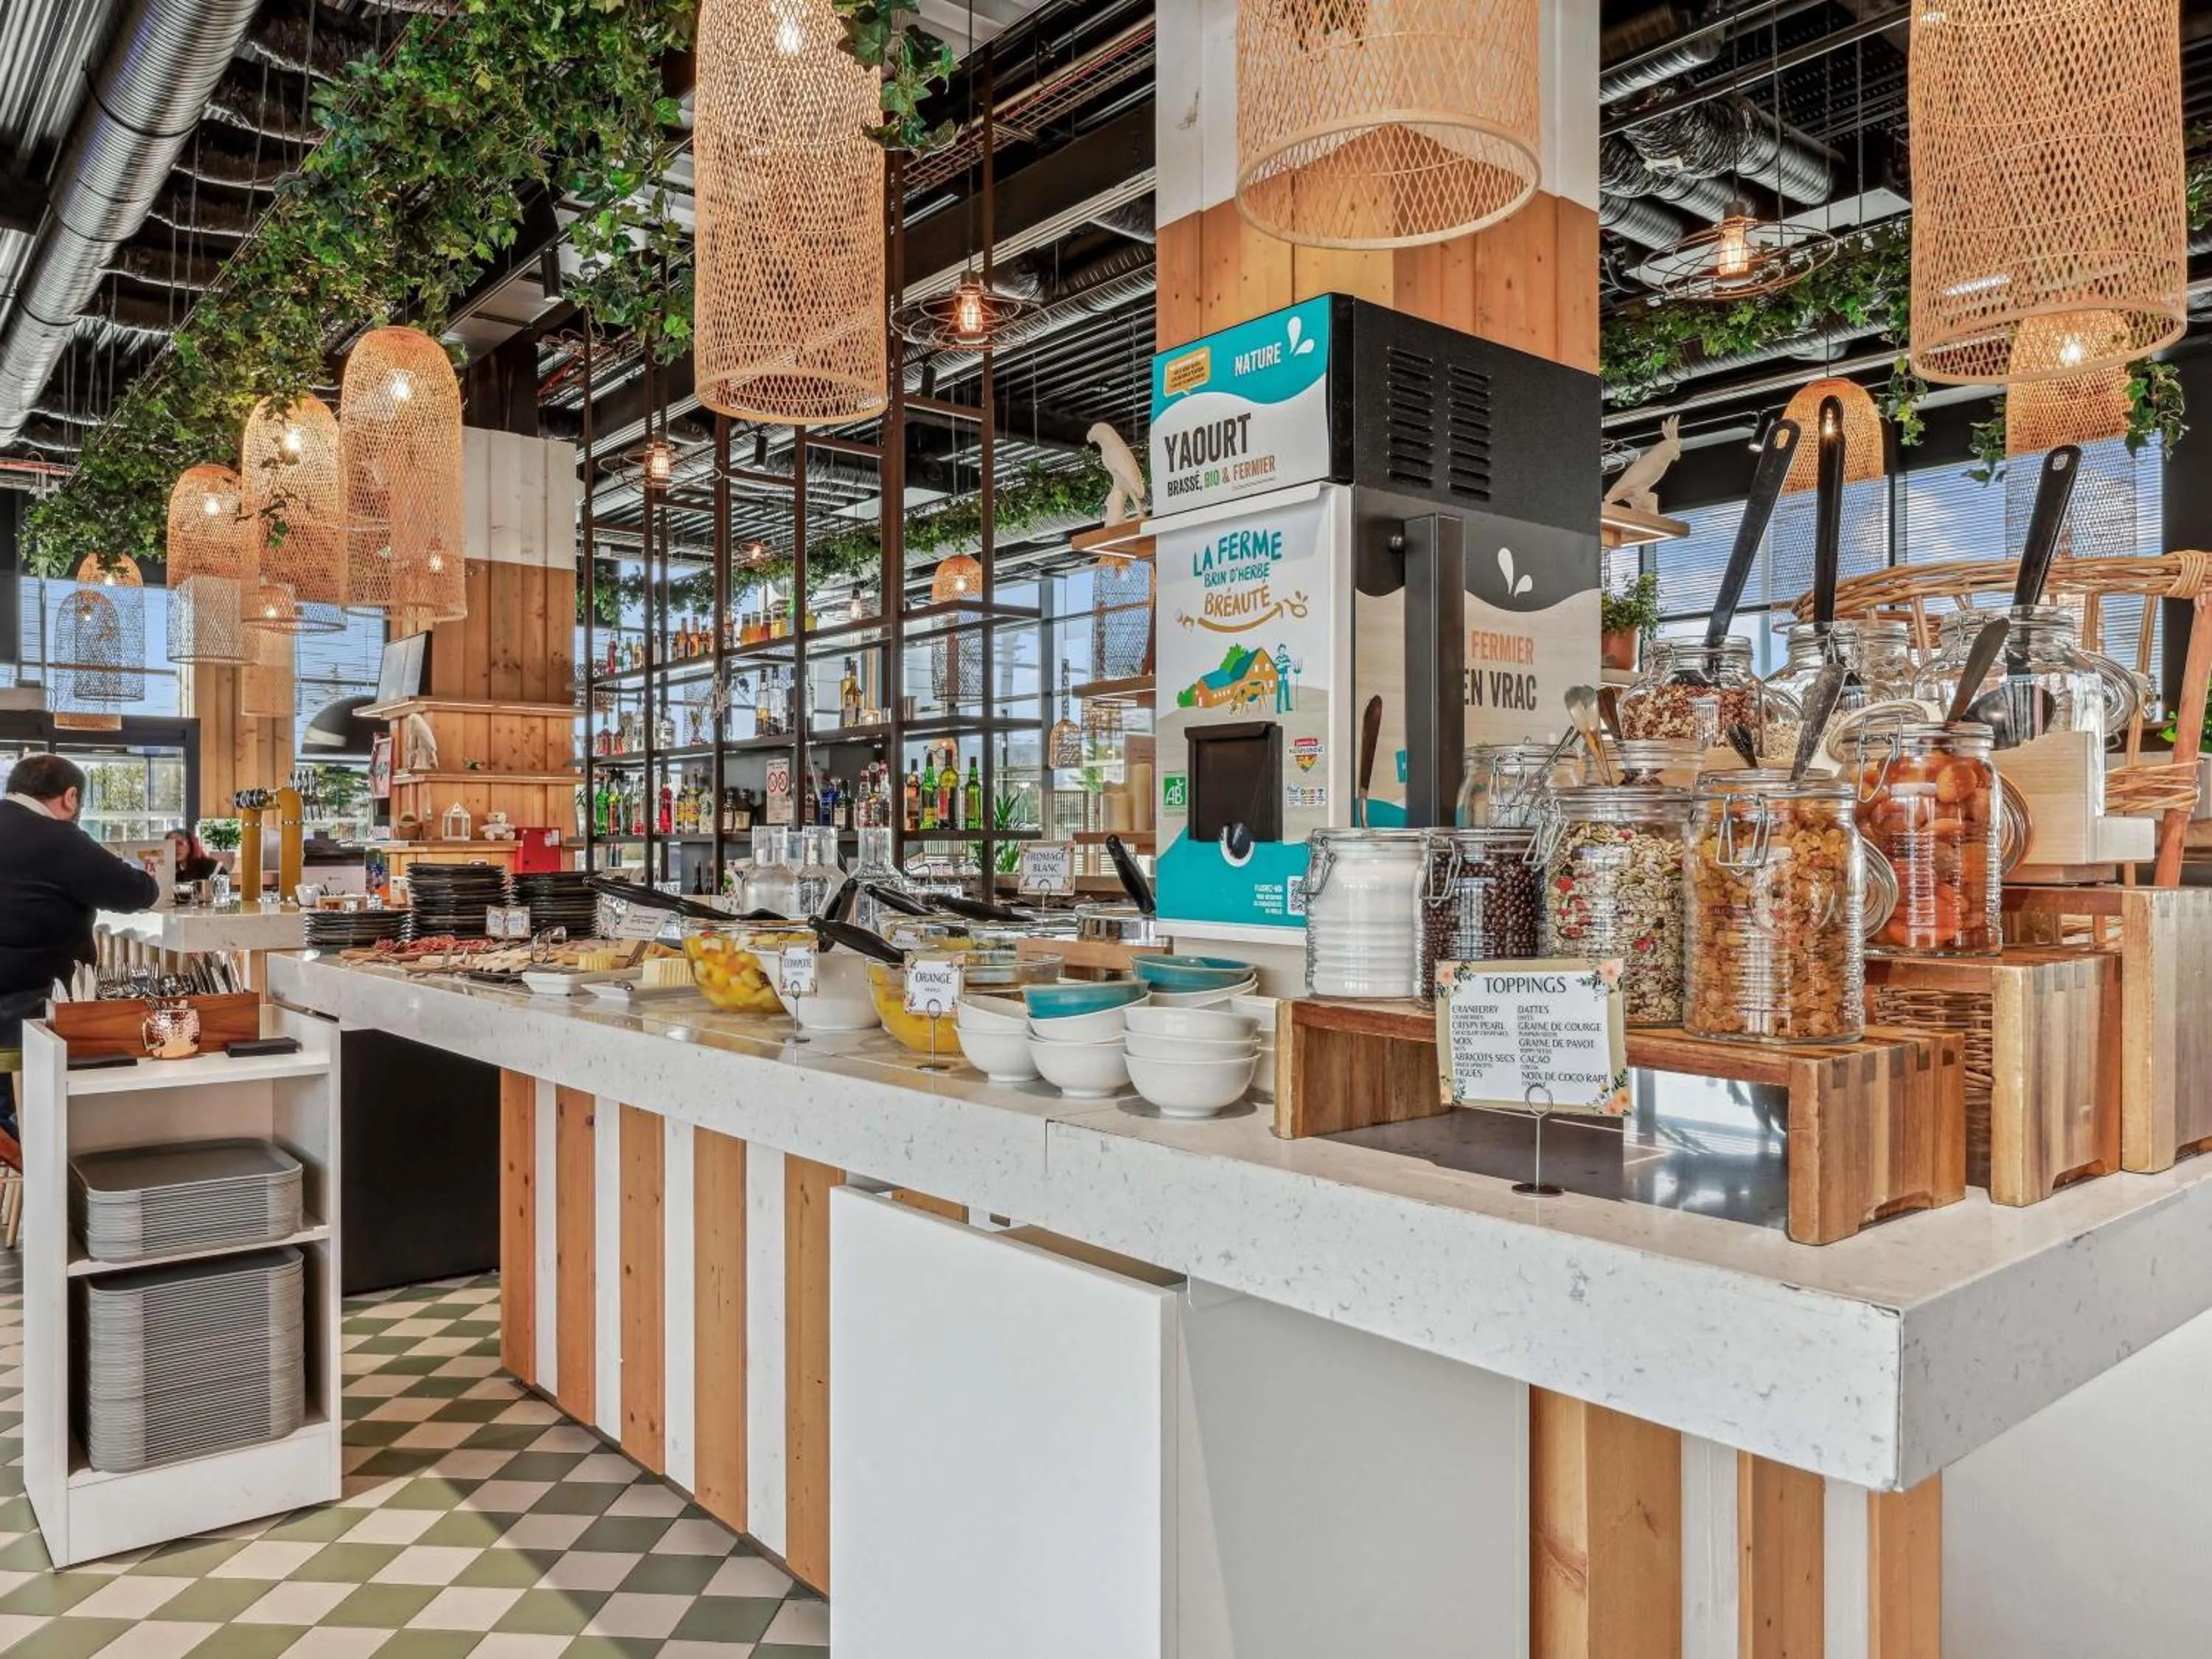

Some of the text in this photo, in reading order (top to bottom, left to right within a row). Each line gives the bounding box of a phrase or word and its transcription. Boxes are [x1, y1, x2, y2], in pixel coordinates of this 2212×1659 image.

[1235, 342, 1282, 376] NATURE
[1164, 412, 1251, 473] YAOURT
[1167, 470, 1203, 497] BRASSÉ,
[1204, 470, 1220, 488] BIO
[1222, 466, 1230, 484] &
[1233, 455, 1276, 481] FERMIER
[1193, 529, 1282, 577] LA FERME
[1204, 562, 1270, 588] BRIN D'HERBE
[1471, 630, 1534, 665] FERMIER
[1489, 670, 1537, 712] VRAC
[1166, 785, 1183, 804] AB
[784, 957, 813, 969] COMPOTE
[914, 971, 953, 985] ORANGE
[1484, 976, 1568, 994] TOPPINGS
[1517, 1005, 1550, 1014] DATTES
[1552, 1039, 1565, 1048] DE
[1495, 1054, 1515, 1062] SECS
